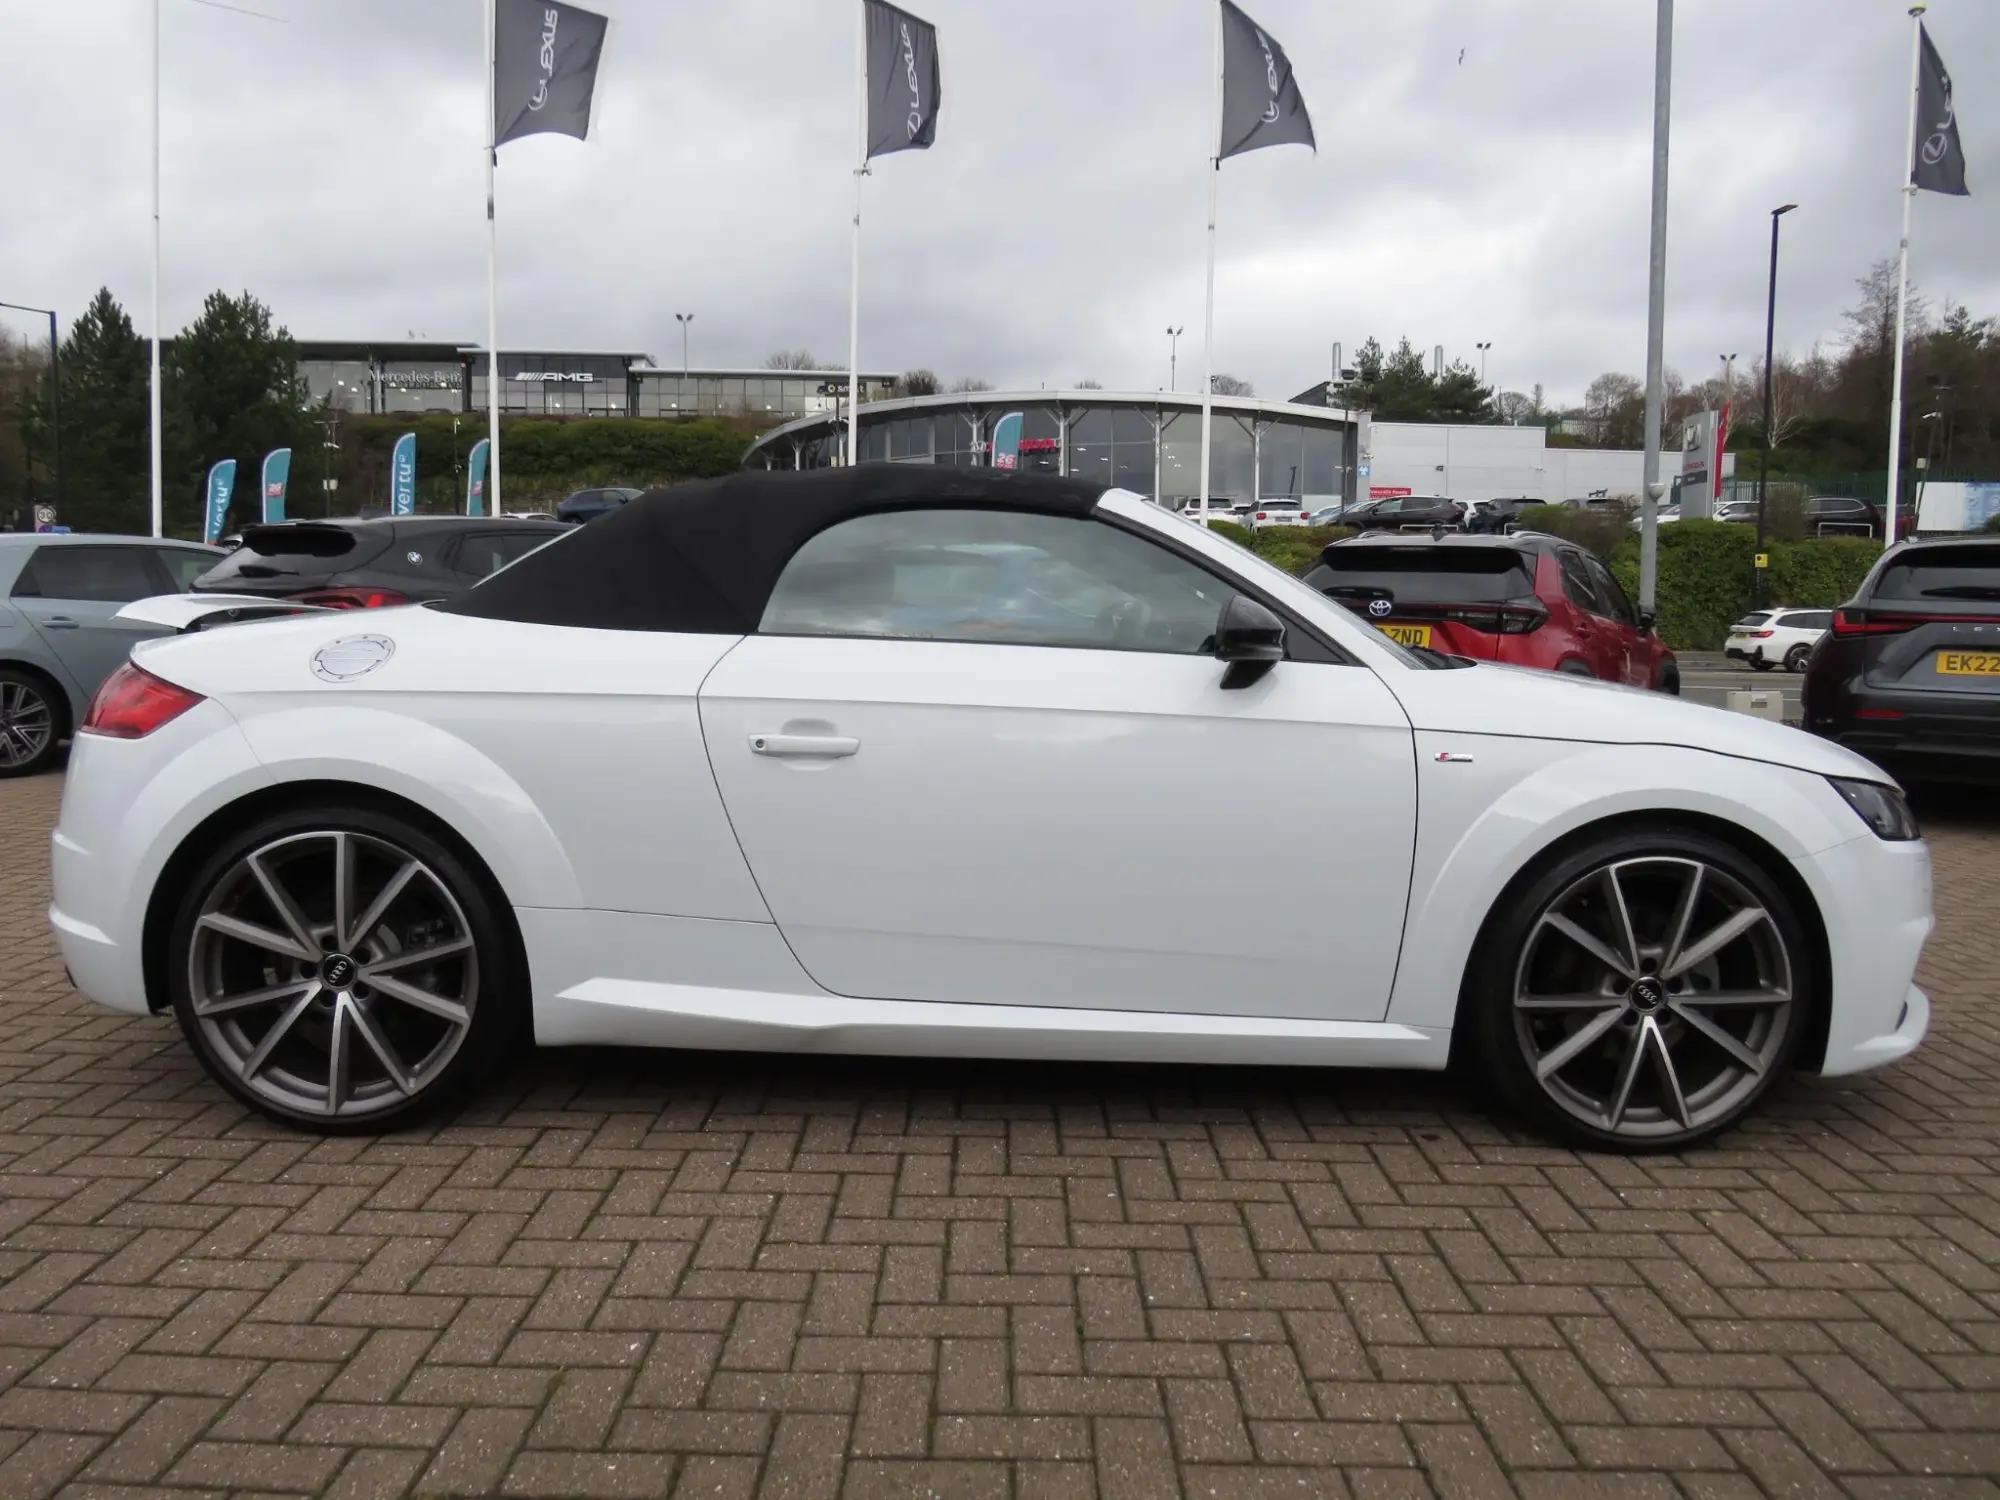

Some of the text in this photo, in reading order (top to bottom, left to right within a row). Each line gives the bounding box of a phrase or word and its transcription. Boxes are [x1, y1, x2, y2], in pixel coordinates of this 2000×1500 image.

[540, 9, 558, 85] LEXUS
[900, 23, 919, 109] LEXUS
[541, 372, 594, 382] AMG
[837, 384, 864, 392] smt
[1946, 654, 2000, 672] EK22
